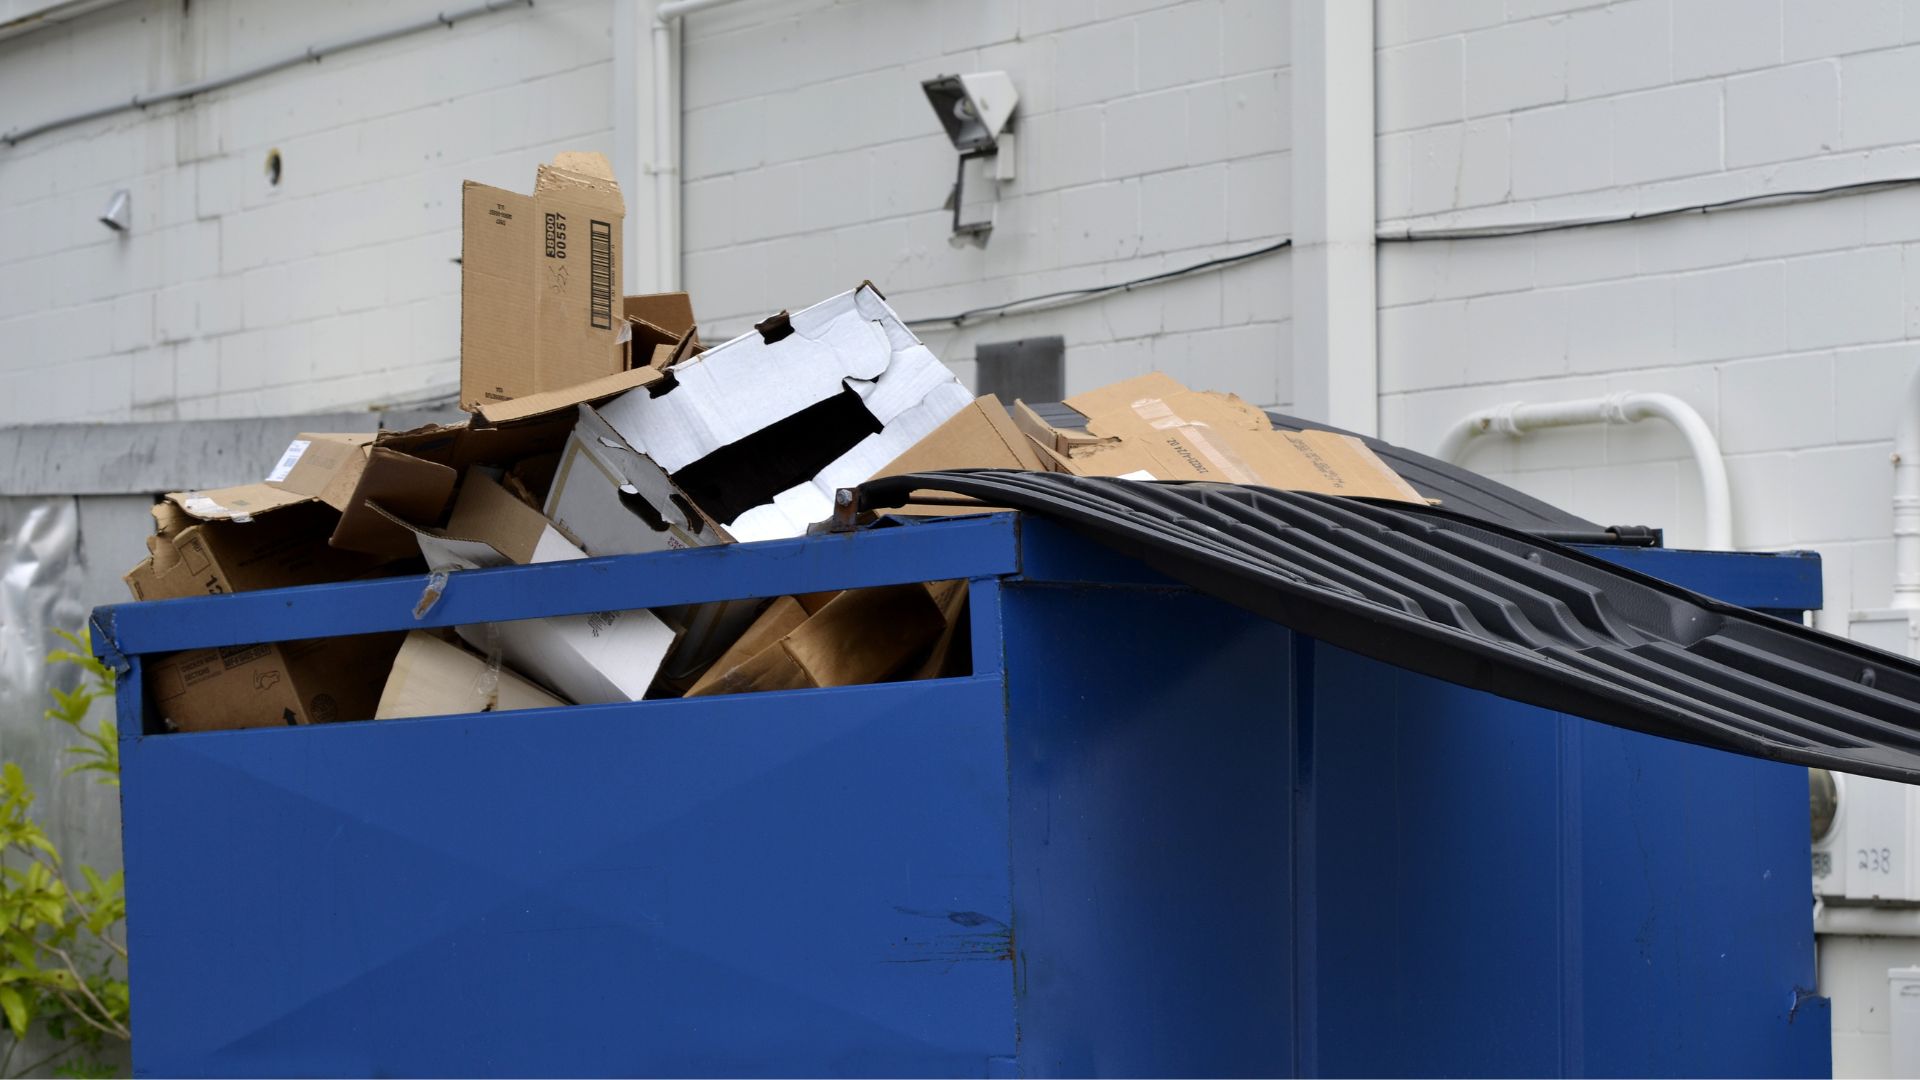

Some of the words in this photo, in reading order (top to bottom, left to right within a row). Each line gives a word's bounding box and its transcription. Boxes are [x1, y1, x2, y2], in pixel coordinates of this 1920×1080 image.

[546, 213, 556, 258] 38900
[556, 212, 567, 259] 00557
[1858, 848, 1891, 874] 238
